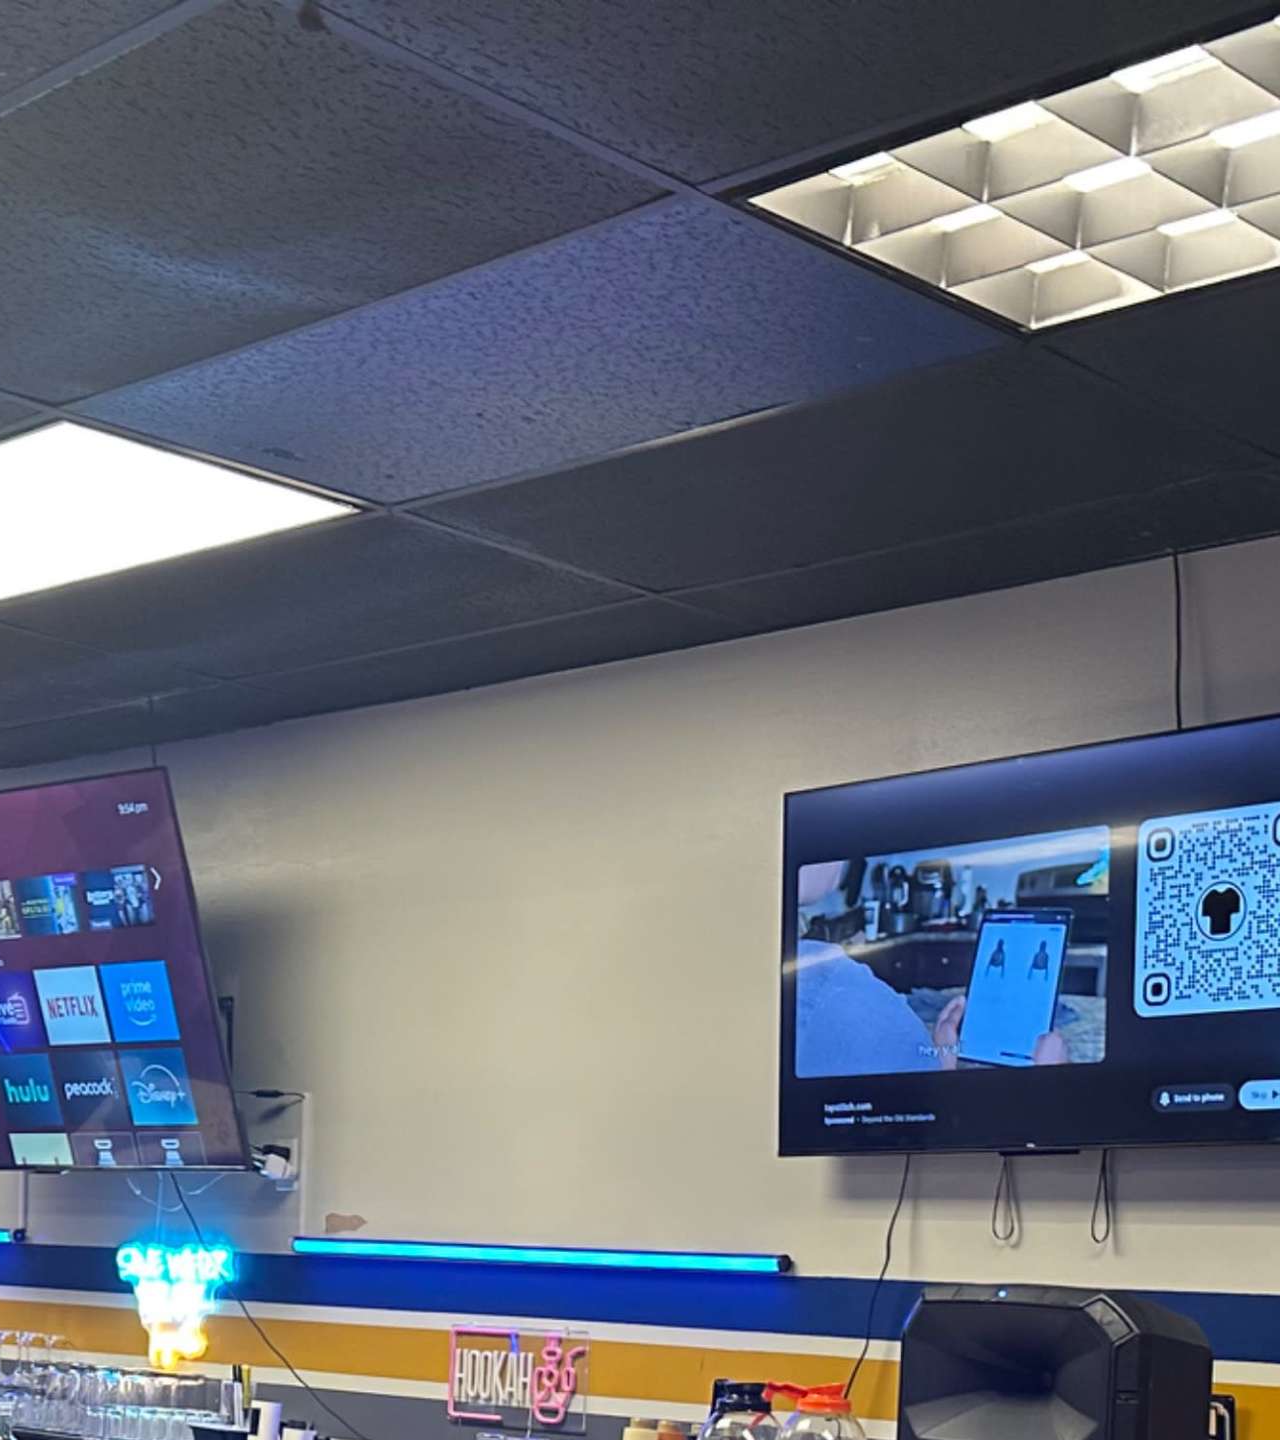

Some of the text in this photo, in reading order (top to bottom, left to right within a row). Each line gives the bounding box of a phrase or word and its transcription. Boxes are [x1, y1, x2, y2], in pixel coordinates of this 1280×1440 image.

[121, 981, 152, 997] prime
[46, 995, 98, 1018] NETFLIX
[126, 997, 156, 1013] video
[3, 1077, 50, 1102] hulu
[64, 1078, 113, 1100] peacock
[455, 1348, 534, 1408] HOOKAH
